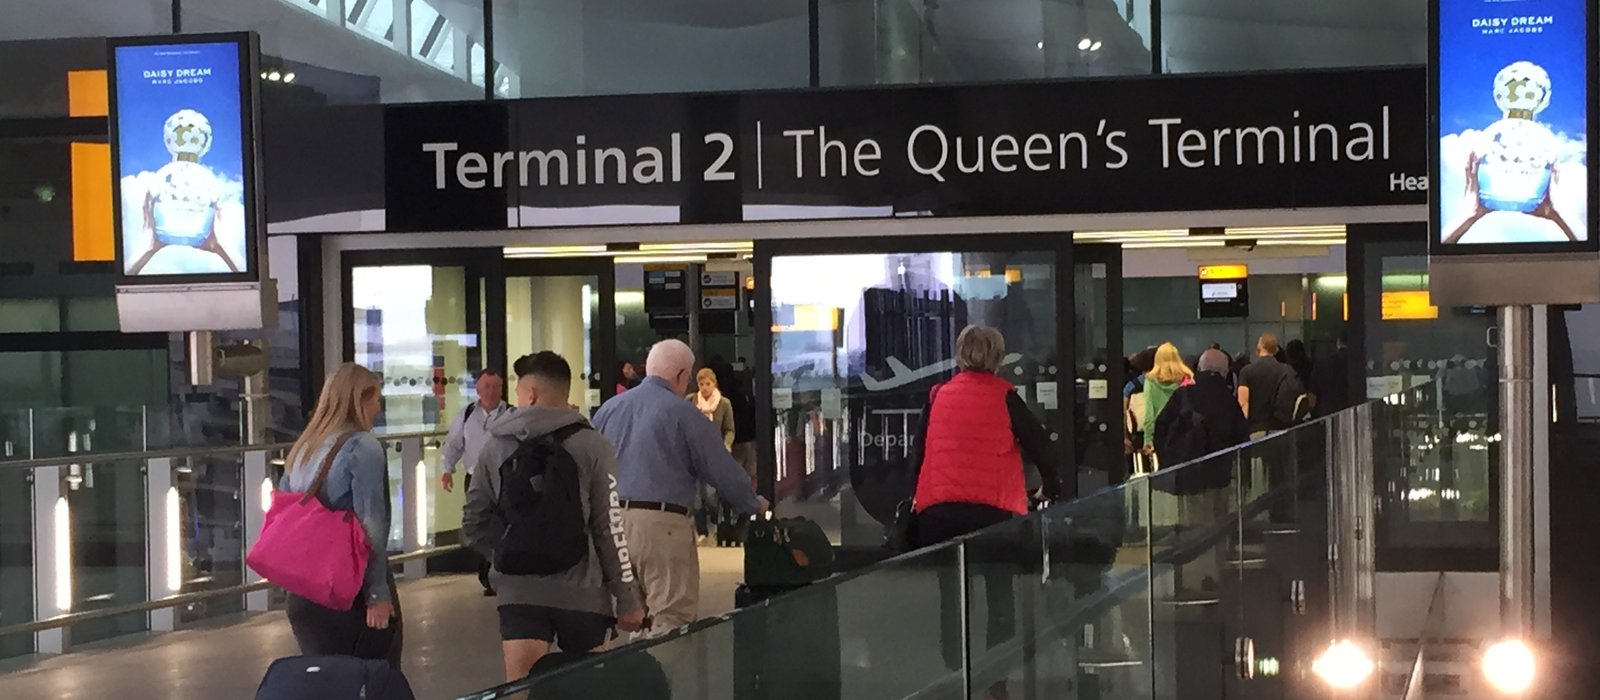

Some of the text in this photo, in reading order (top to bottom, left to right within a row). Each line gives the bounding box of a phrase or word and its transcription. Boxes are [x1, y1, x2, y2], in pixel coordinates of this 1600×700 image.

[1472, 16, 1553, 27] DAISY DREAM
[143, 68, 212, 78] DAISY DREAM
[422, 132, 681, 189] Terminal
[703, 132, 736, 181] 2
[783, 125, 882, 178] The
[1148, 105, 1390, 168] Terminal
